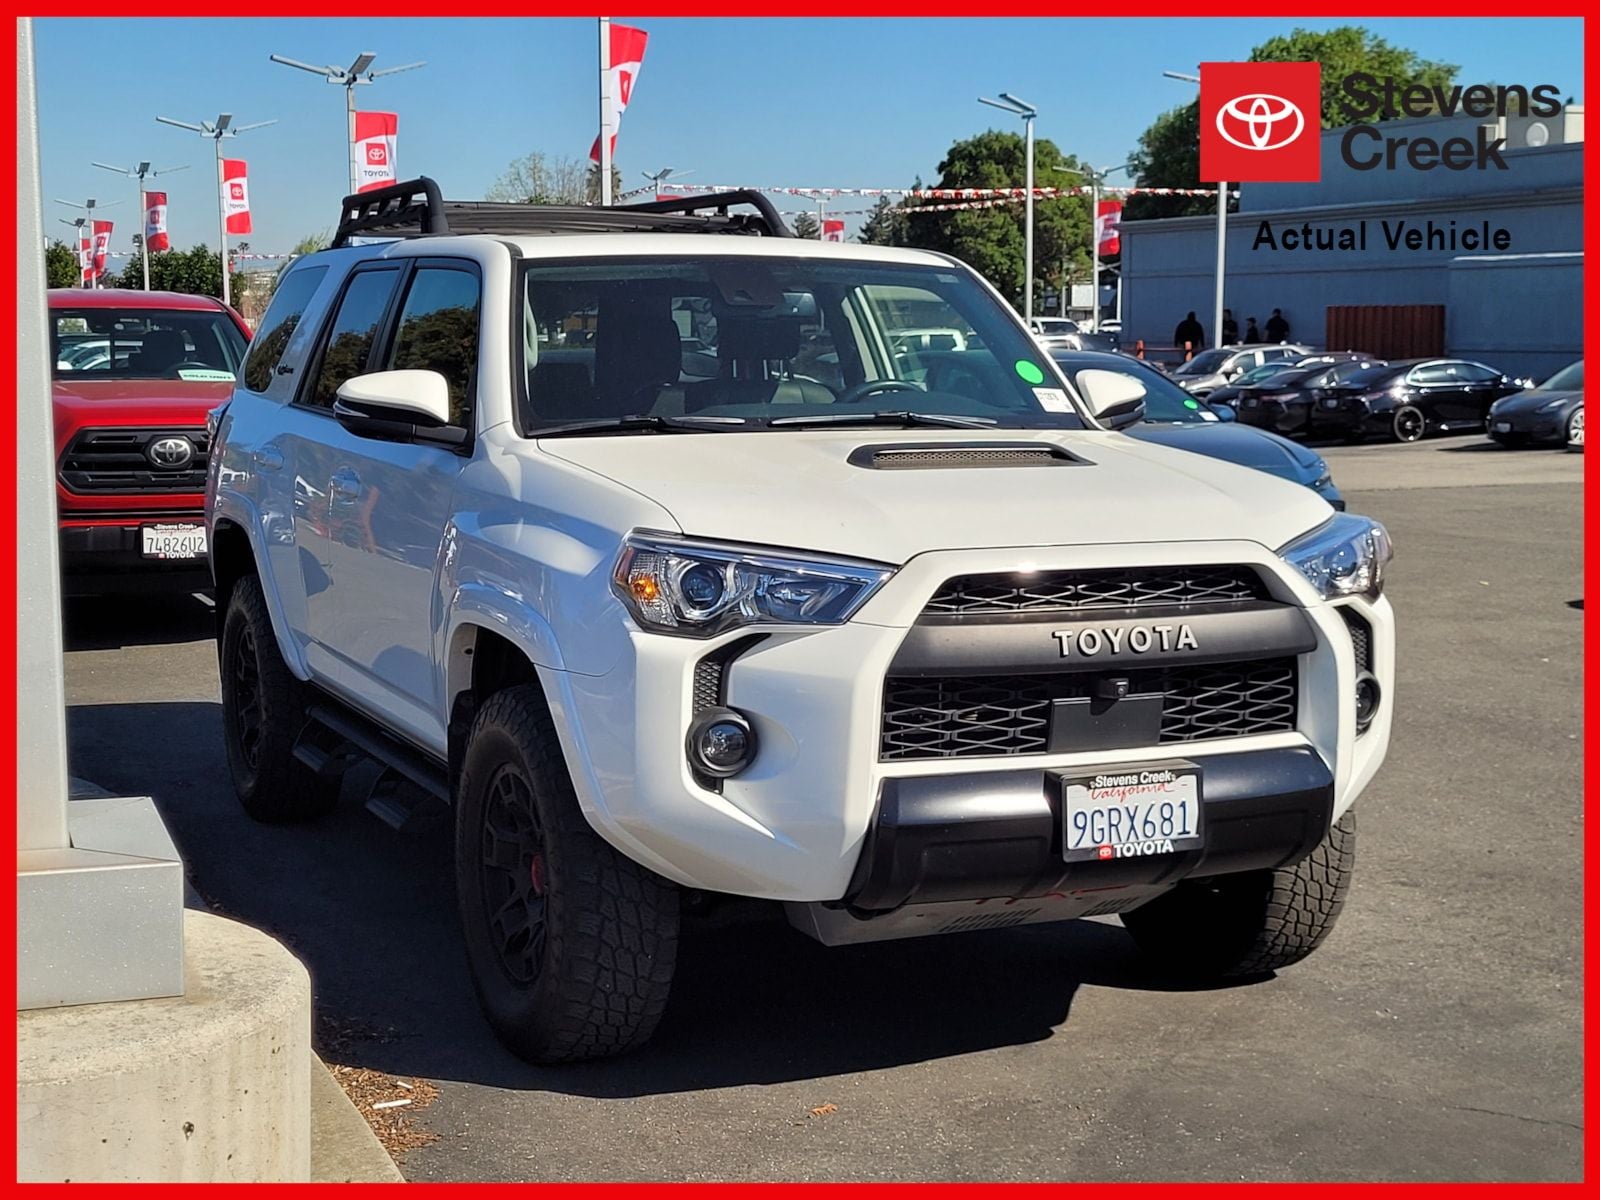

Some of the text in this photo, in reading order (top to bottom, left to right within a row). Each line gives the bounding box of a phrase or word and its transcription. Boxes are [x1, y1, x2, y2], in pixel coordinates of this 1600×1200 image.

[146, 536, 205, 553] 74826U2
[166, 551, 195, 559] TOYOTA
[1052, 624, 1199, 657] TOYOTA
[1095, 770, 1172, 788] Stevens Creek
[1073, 800, 1191, 848] 9GRX681
[1114, 839, 1174, 858] TOYOTA
